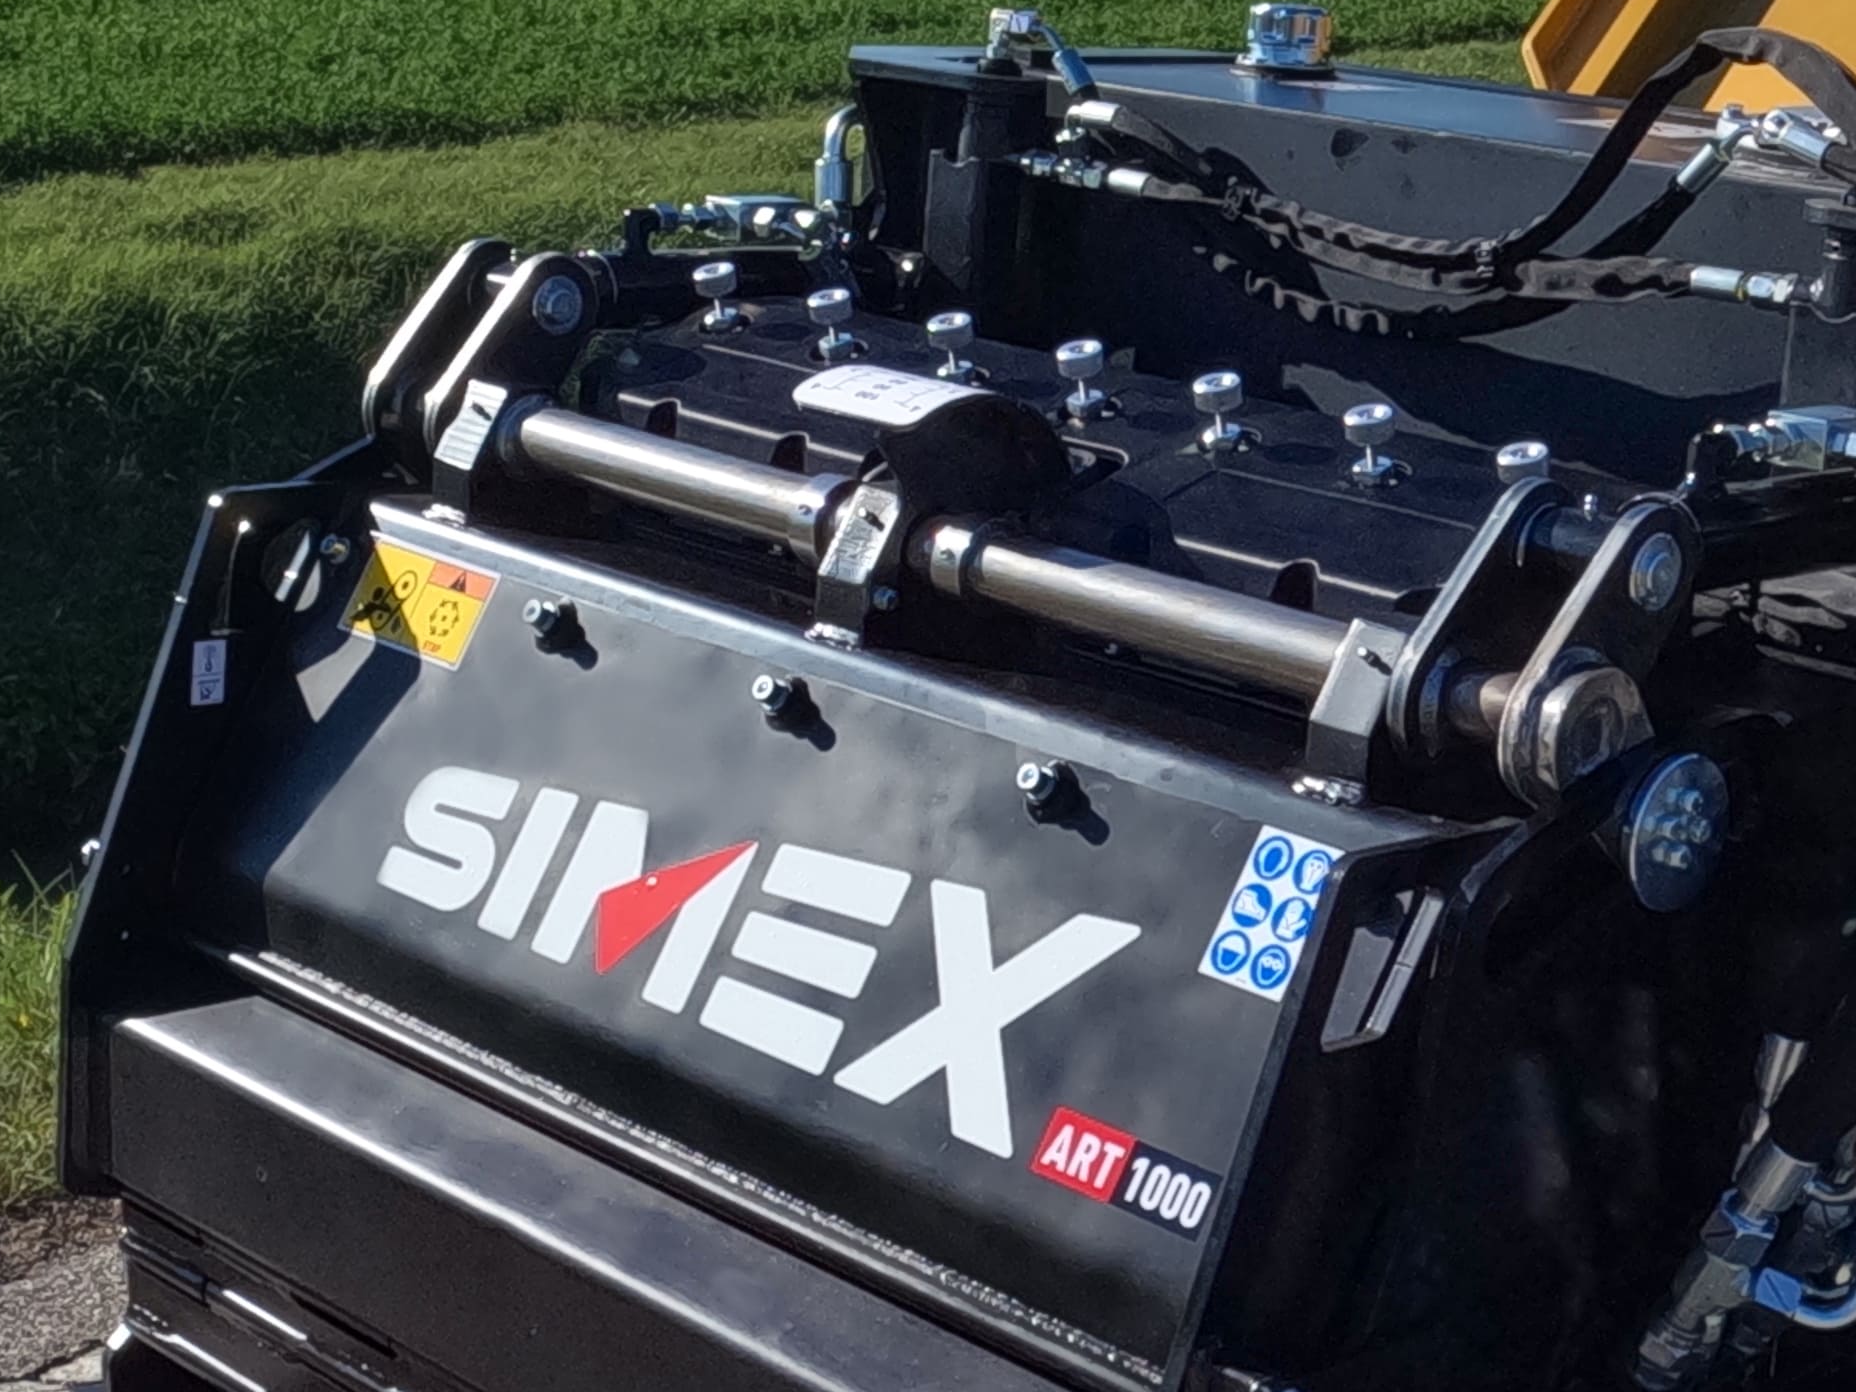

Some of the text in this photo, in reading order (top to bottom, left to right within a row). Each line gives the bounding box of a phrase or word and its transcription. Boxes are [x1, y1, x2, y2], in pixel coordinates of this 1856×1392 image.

[377, 765, 1142, 1158] SIMEX
[1040, 1123, 1212, 1229] ART 1000
